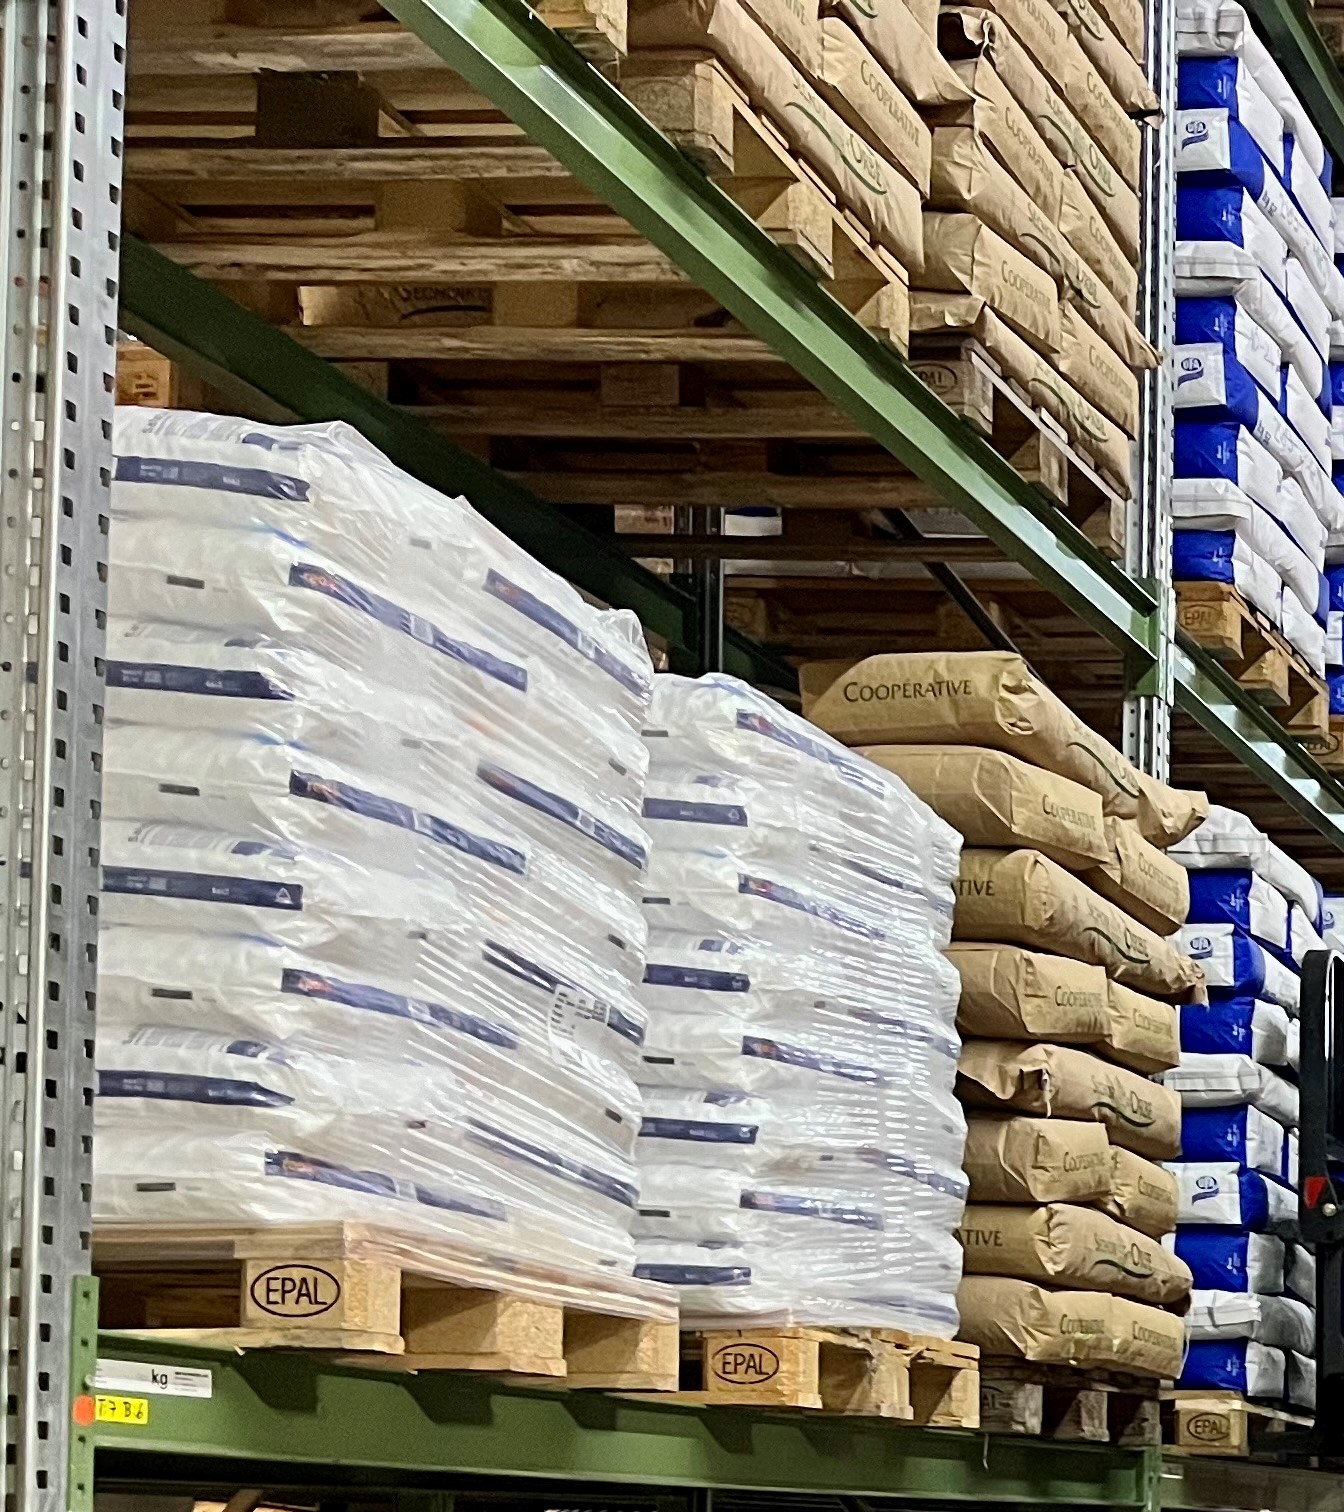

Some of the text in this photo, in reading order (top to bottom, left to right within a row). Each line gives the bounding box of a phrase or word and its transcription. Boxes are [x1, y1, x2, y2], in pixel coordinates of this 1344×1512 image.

[265, 1274, 328, 1307] EPAL
[720, 1351, 770, 1378] EPAL
[152, 1368, 168, 1390] kg
